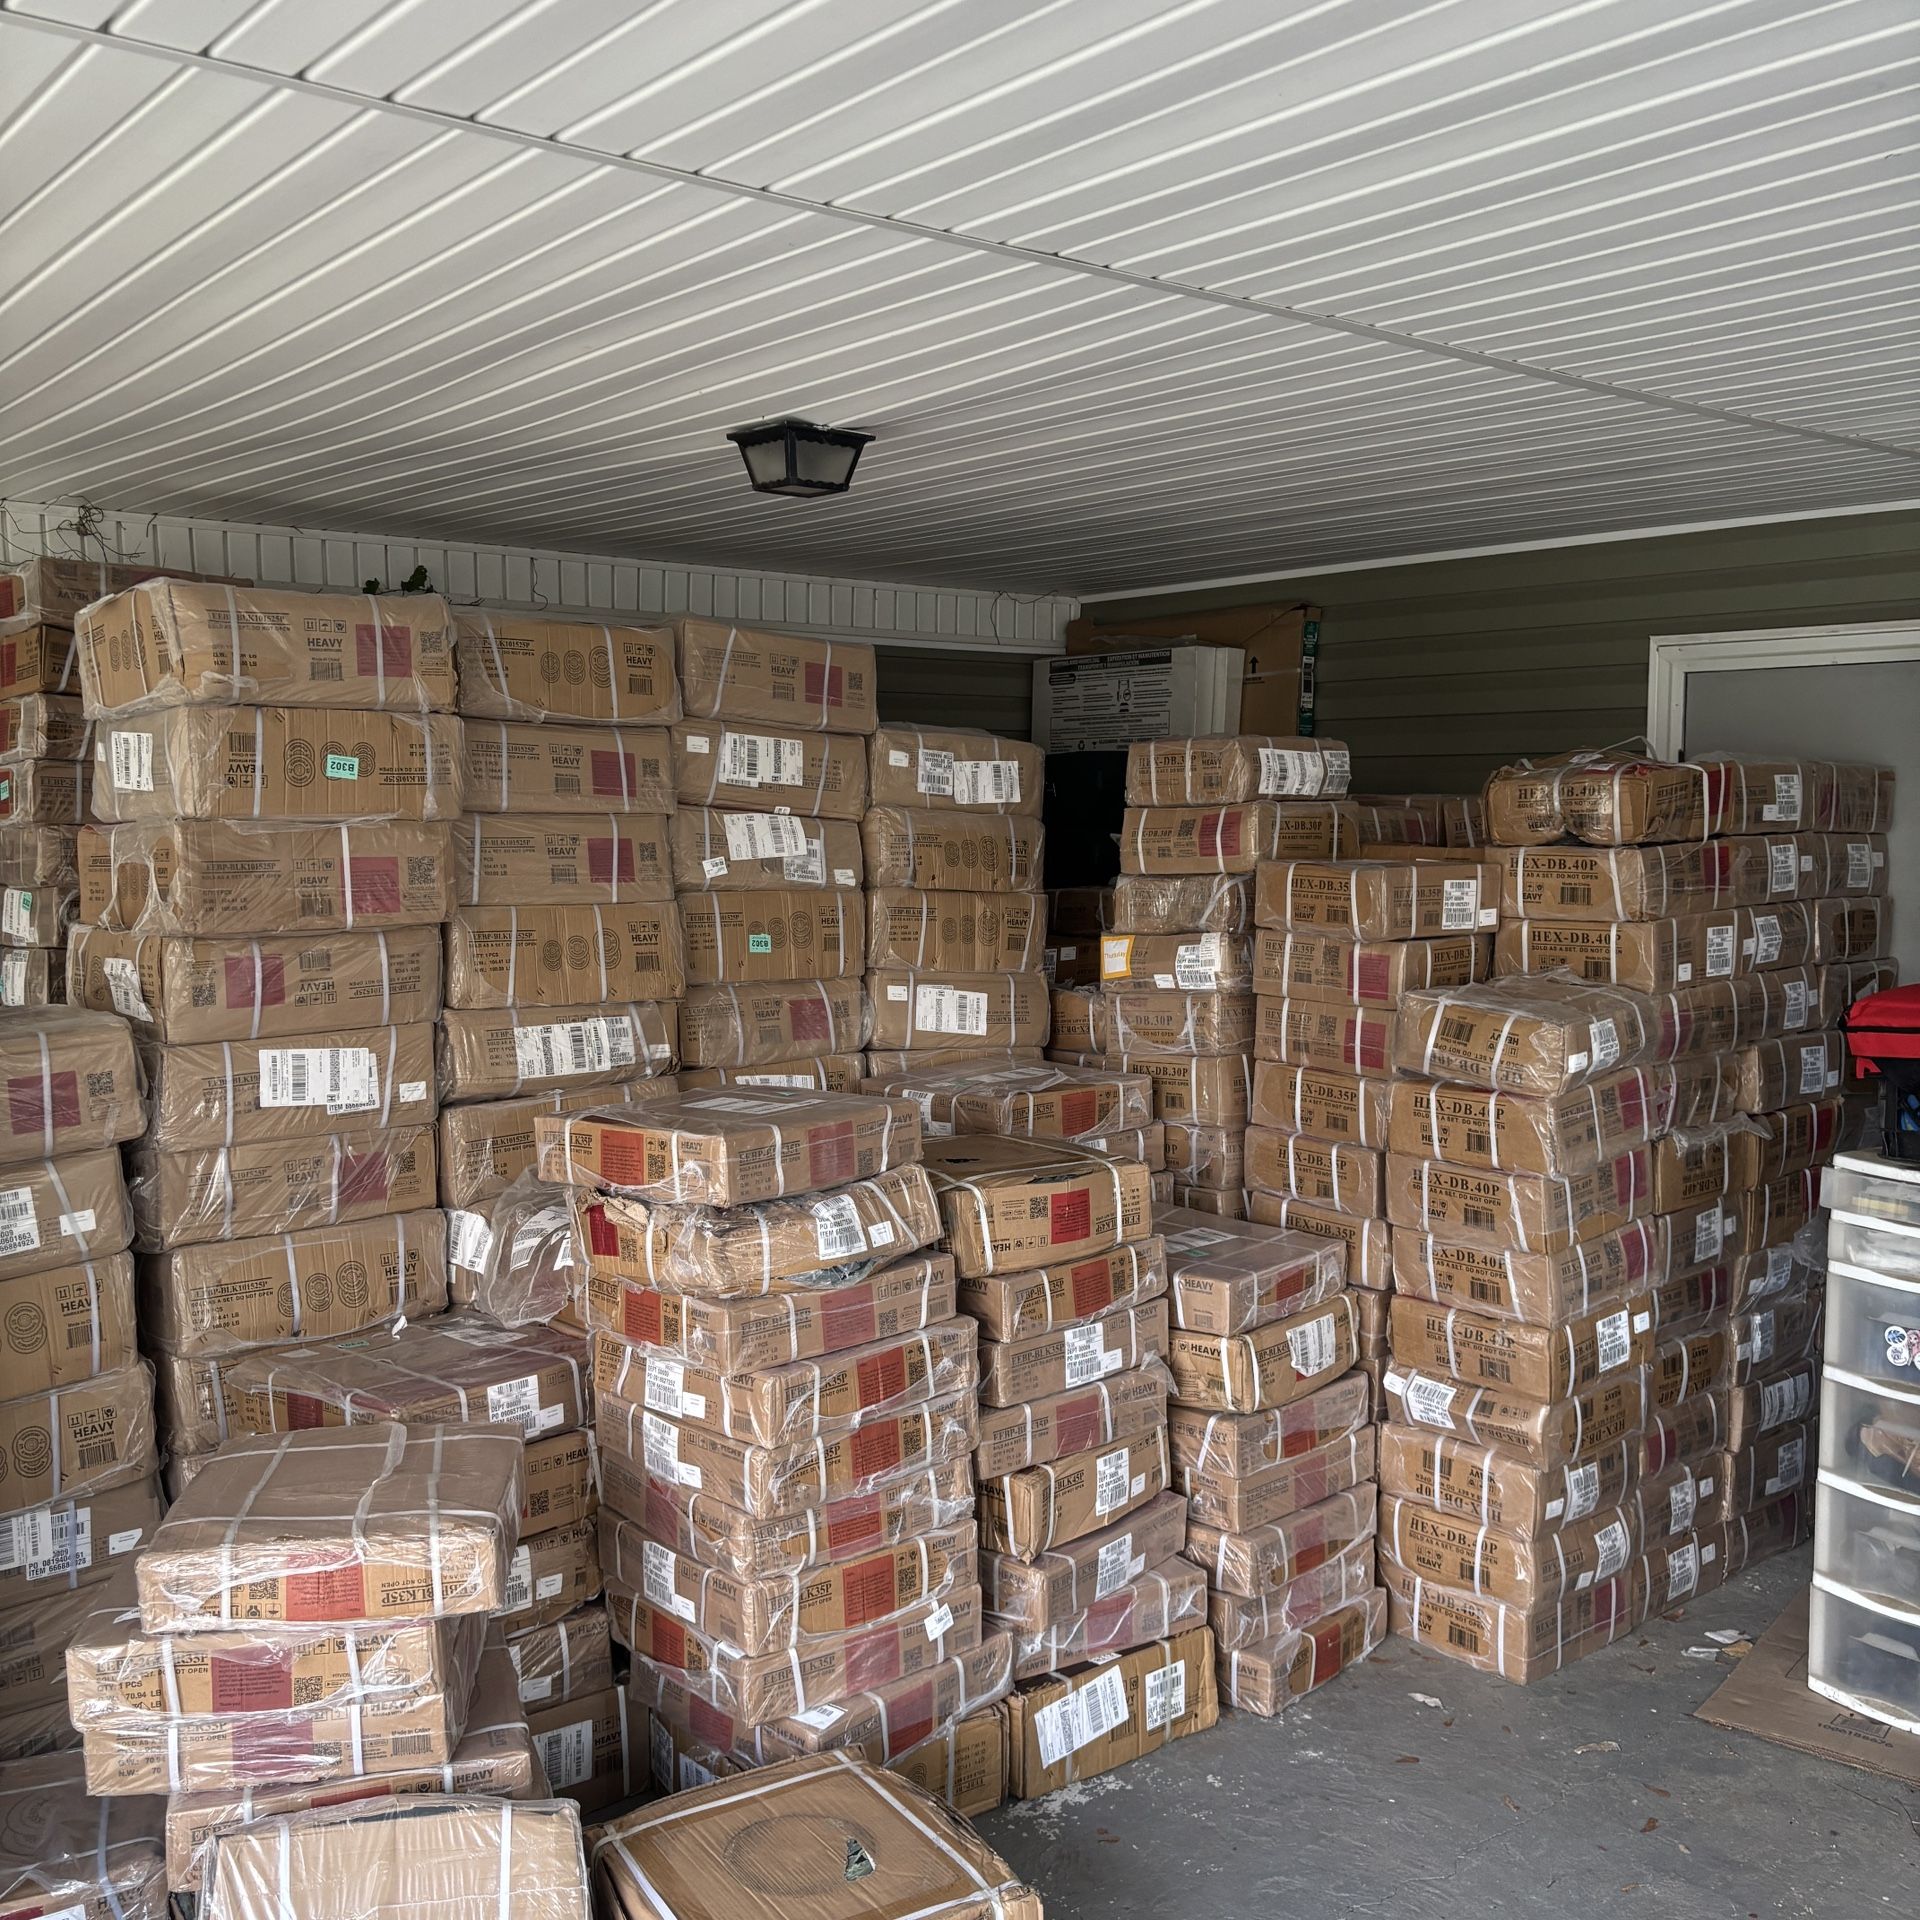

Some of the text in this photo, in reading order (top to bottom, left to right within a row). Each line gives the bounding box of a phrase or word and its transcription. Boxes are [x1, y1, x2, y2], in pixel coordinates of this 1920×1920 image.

[307, 637, 343, 649] HEAVY
[626, 656, 653, 665] HEAVY
[771, 665, 797, 675] HEAVY
[552, 756, 580, 765] HEAVY
[228, 763, 257, 774] EAVY
[330, 761, 355, 772] B302
[547, 847, 577, 856] HEAVY
[300, 876, 329, 885] HEAVY
[1291, 878, 1349, 892] HEX-DB.35
[1294, 911, 1315, 920] HEAVY
[631, 933, 659, 943] HEAVY
[751, 939, 769, 947] B302
[1532, 944, 1547, 952] SOLD
[299, 981, 335, 992] HEAVY
[755, 1010, 781, 1018] HEAVY
[329, 1103, 343, 1111] ITEM
[681, 1141, 703, 1150] HEAVY
[888, 1174, 918, 1190] HEAVY
[1287, 1215, 1356, 1240] HEX-DB.35P
[820, 1230, 834, 1238] ITEM
[960, 1278, 988, 1291] HEAVY
[1184, 1278, 1214, 1291] HEAVY
[836, 1386, 848, 1395] OPEN
[1132, 1382, 1158, 1396] HEAVY
[491, 1403, 505, 1412] DEPT
[73, 1420, 114, 1438] HEAVY
[709, 1513, 733, 1533] HEAVY
[933, 1535, 956, 1551] HEAVY
[28, 1562, 38, 1570] PO
[1416, 1555, 1442, 1570] HEAVY
[28, 1568, 46, 1577] ITEM
[381, 1580, 400, 1588] OPEN
[417, 1577, 426, 1585] DO
[713, 1576, 737, 1597] HEAVY
[126, 1689, 162, 1700] 70.94 LB
[150, 1700, 162, 1709] LB
[595, 1731, 622, 1745] HEAVY
[776, 1727, 805, 1748] HEAVY
[118, 1766, 162, 1777] N.W.: 70
[456, 1768, 495, 1784] HEAVY
